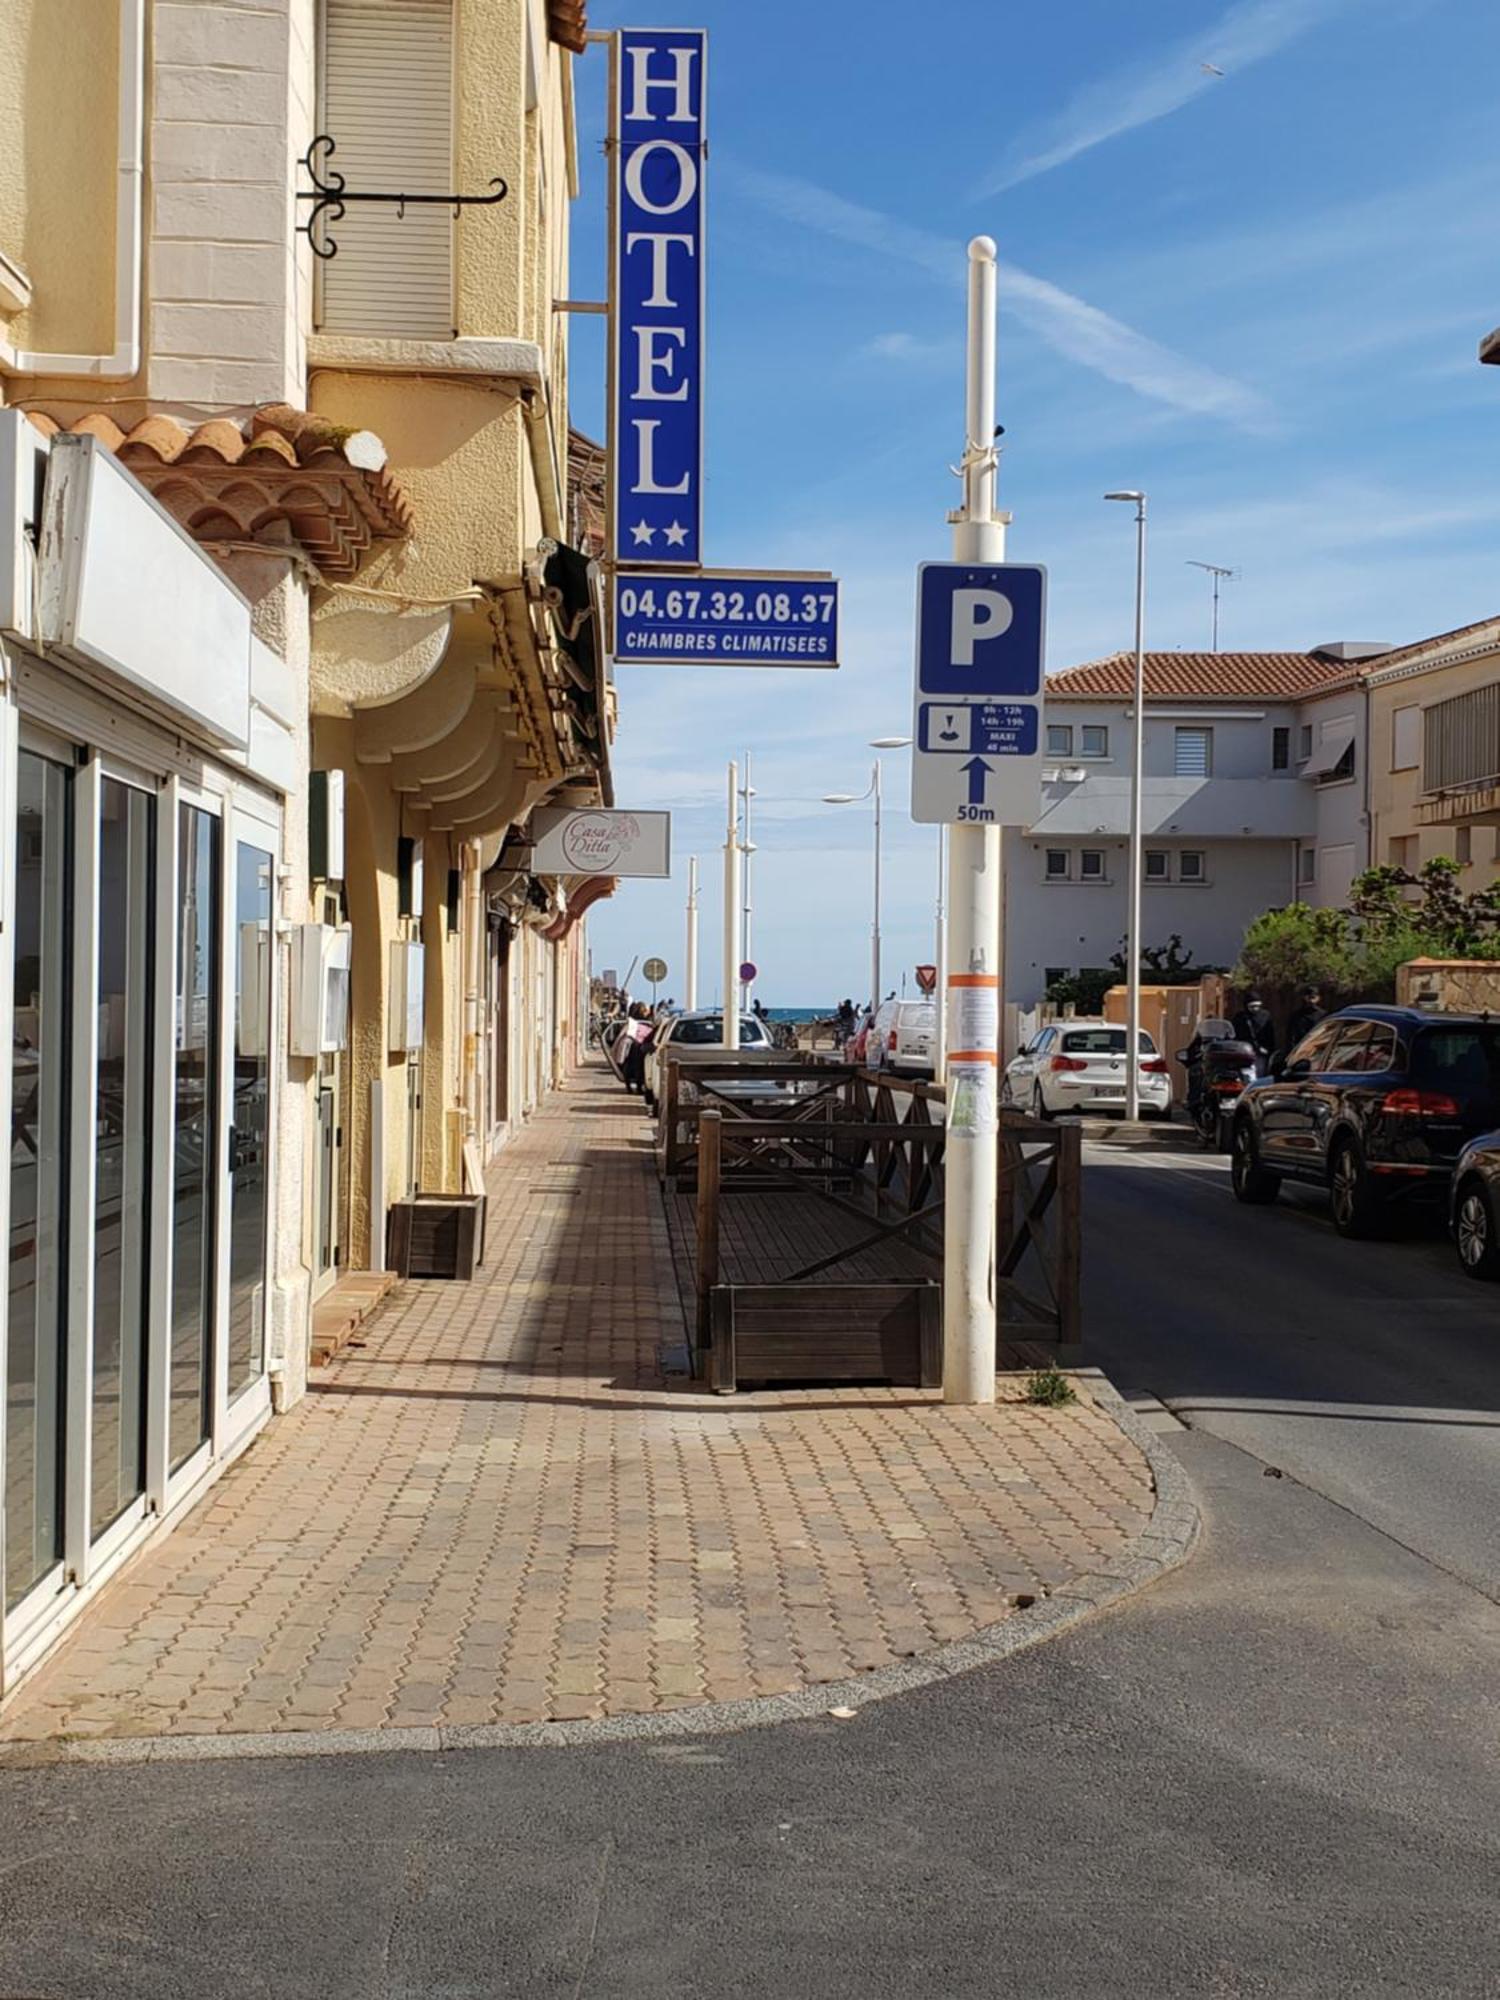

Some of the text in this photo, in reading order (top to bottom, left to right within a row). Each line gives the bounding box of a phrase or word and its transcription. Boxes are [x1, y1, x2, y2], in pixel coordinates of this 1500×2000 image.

[625, 47, 698, 494] HOTEL
[620, 588, 835, 623] 04.67.32.08.37
[950, 588, 1014, 666] P
[626, 631, 828, 653] CHAMBRES CLIMATISEES
[1003, 706, 1022, 715] 12h
[1006, 717, 1025, 727] 19h
[990, 732, 1016, 741] MAXI
[999, 743, 1019, 752] min
[957, 805, 995, 821] 50m
[570, 822, 606, 838] Casa
